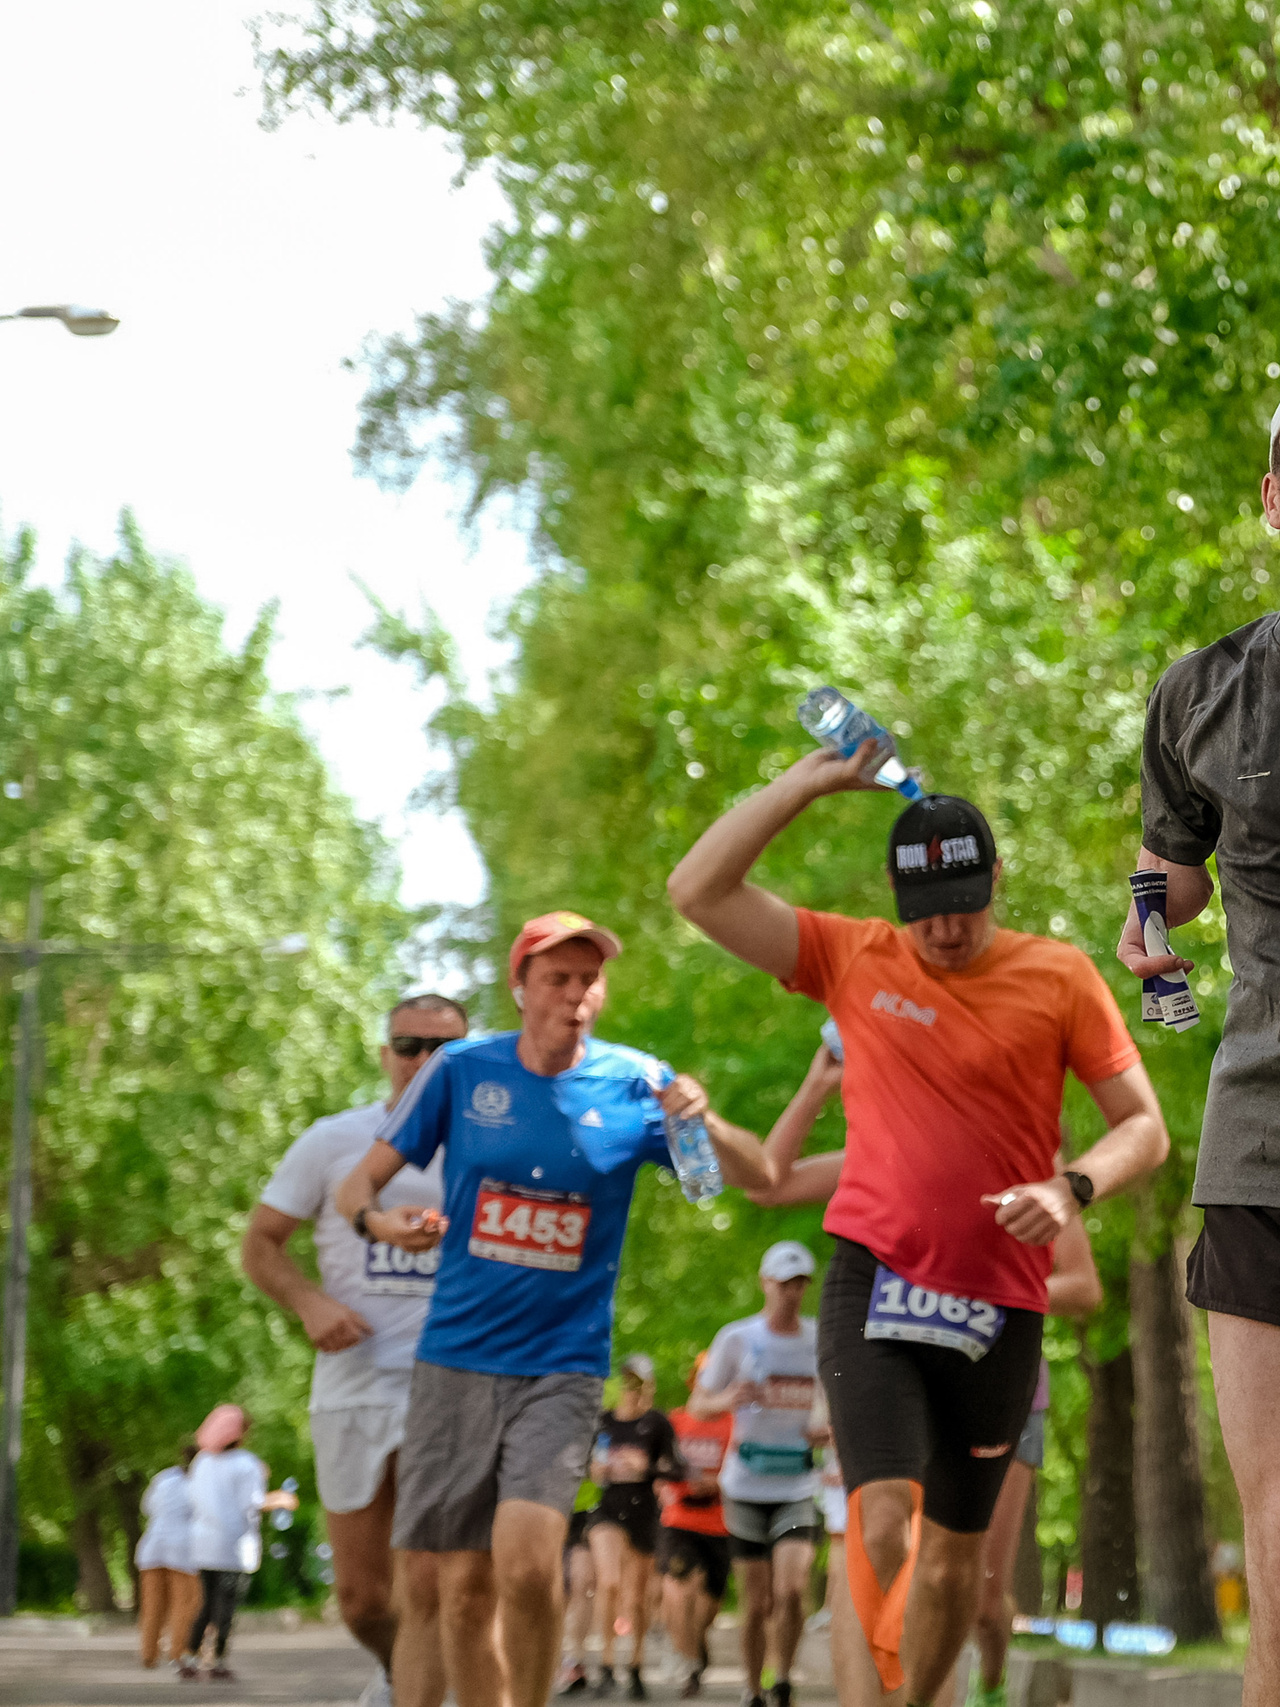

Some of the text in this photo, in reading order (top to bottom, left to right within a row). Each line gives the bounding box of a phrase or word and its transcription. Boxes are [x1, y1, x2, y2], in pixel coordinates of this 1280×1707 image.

[940, 834, 980, 864] STAR
[478, 1200, 584, 1247] 1453
[875, 1278, 998, 1337] 1062
